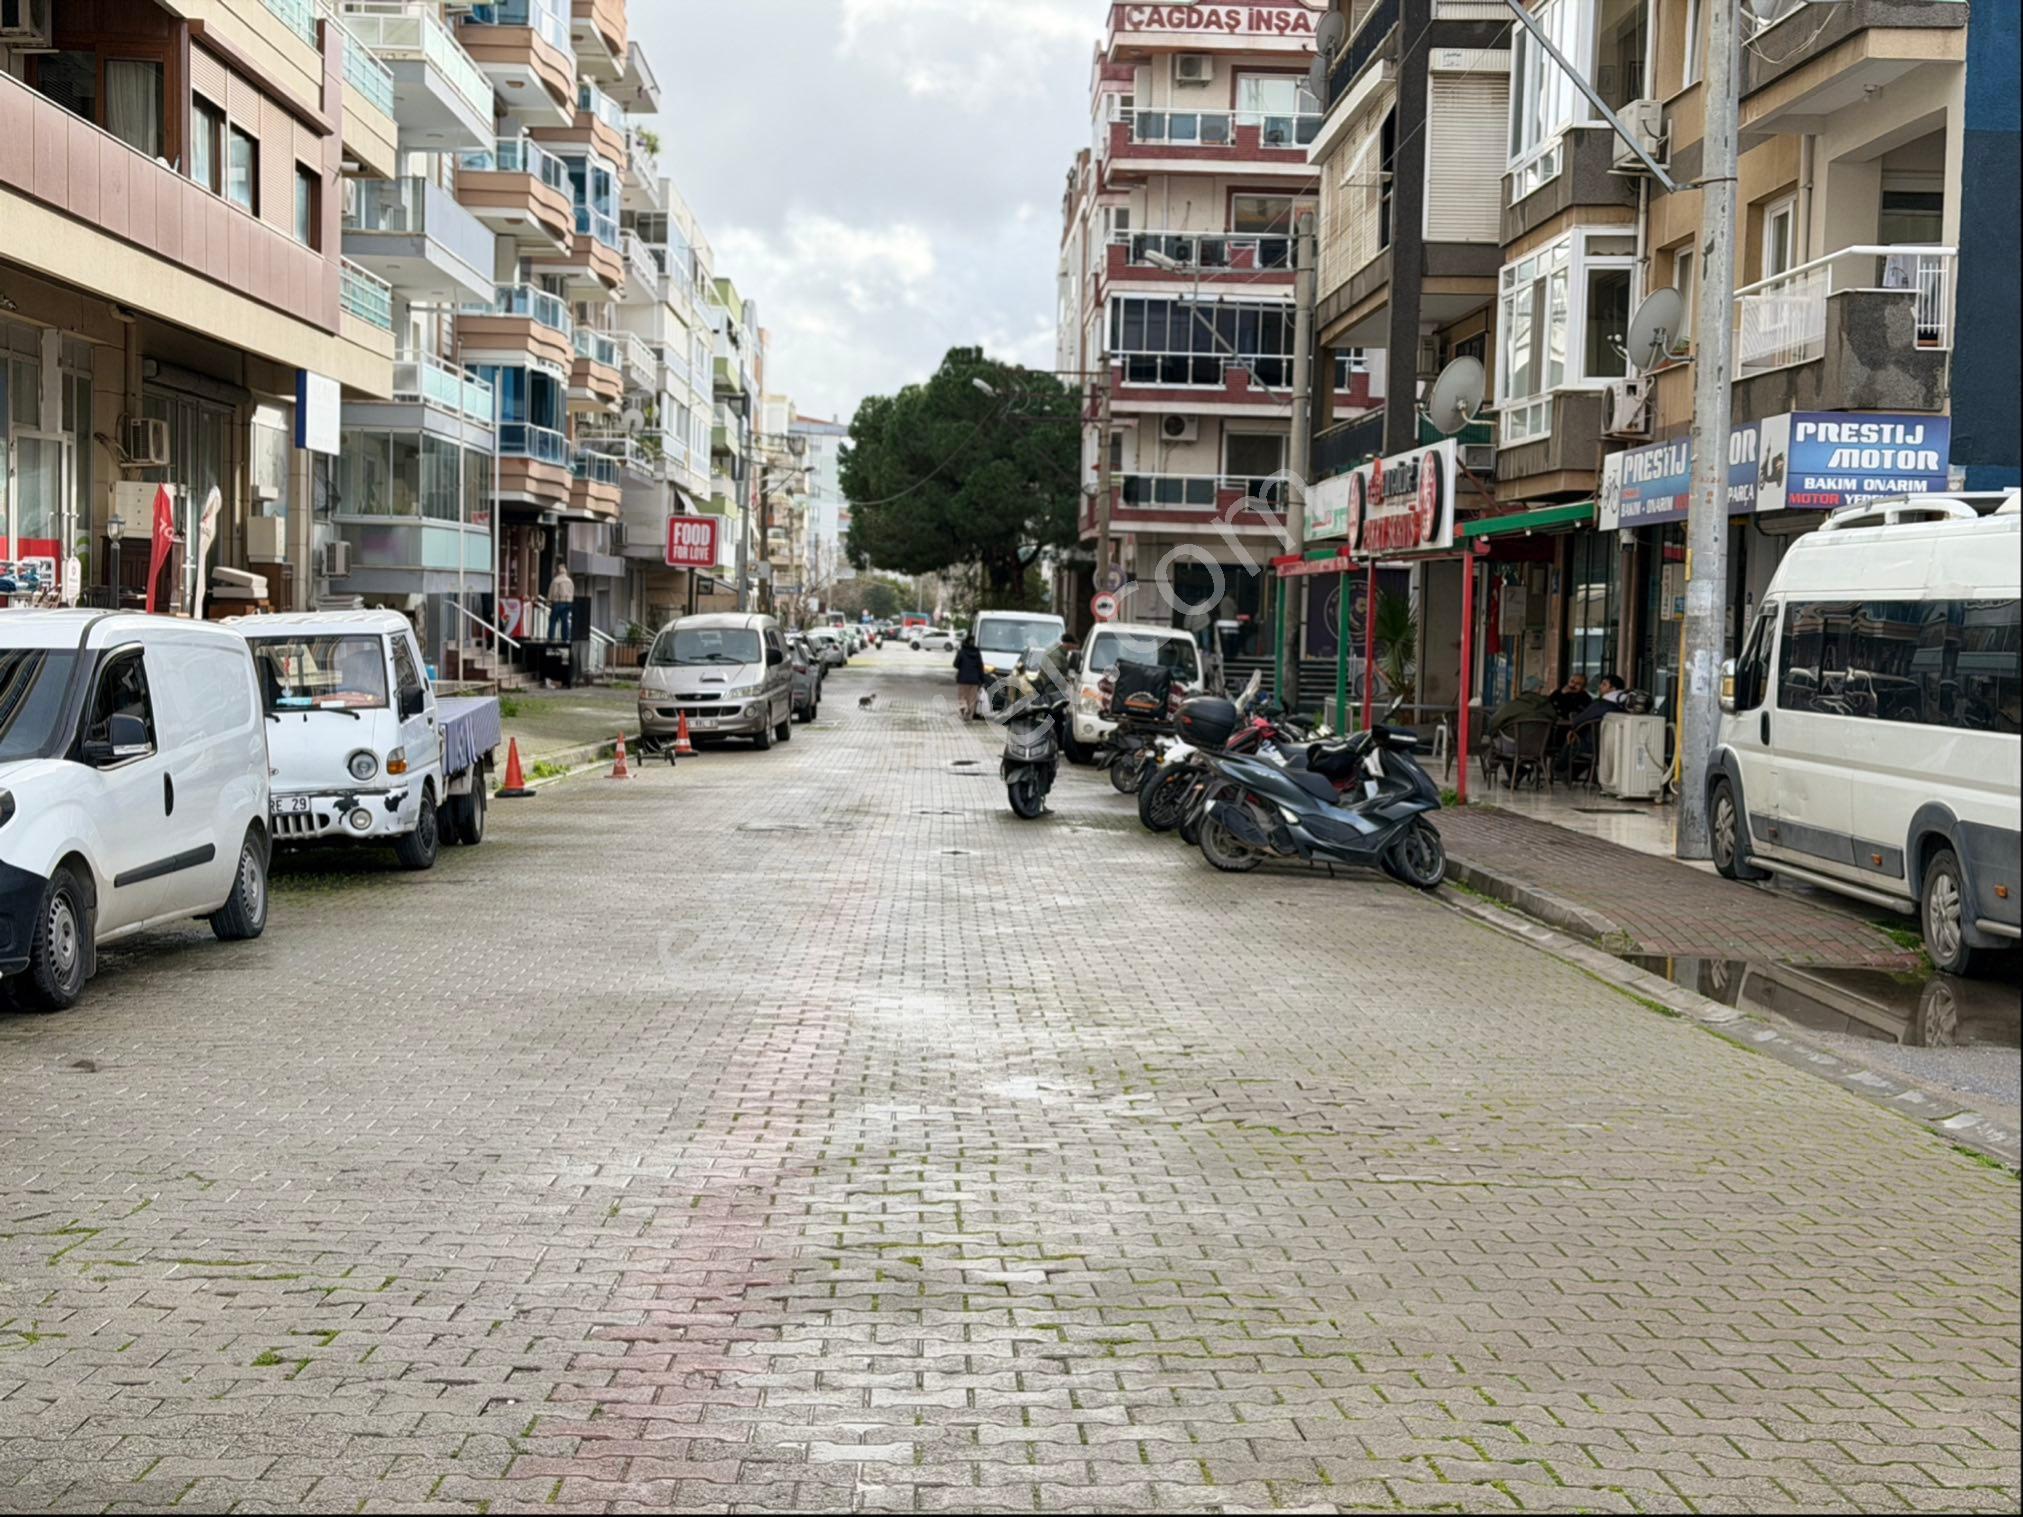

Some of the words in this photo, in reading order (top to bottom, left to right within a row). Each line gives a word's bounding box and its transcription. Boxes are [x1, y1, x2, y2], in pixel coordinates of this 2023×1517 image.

[1827, 448, 1940, 470] MOTOR
[1804, 477, 1857, 491] BAKIM
[1863, 478, 1928, 492] ONARIM
[1788, 493, 1839, 505] MOTOR
[673, 522, 711, 546] FOOD
[673, 545, 689, 559] FOR
[689, 547, 710, 561] LOVE
[292, 797, 307, 811] 29
